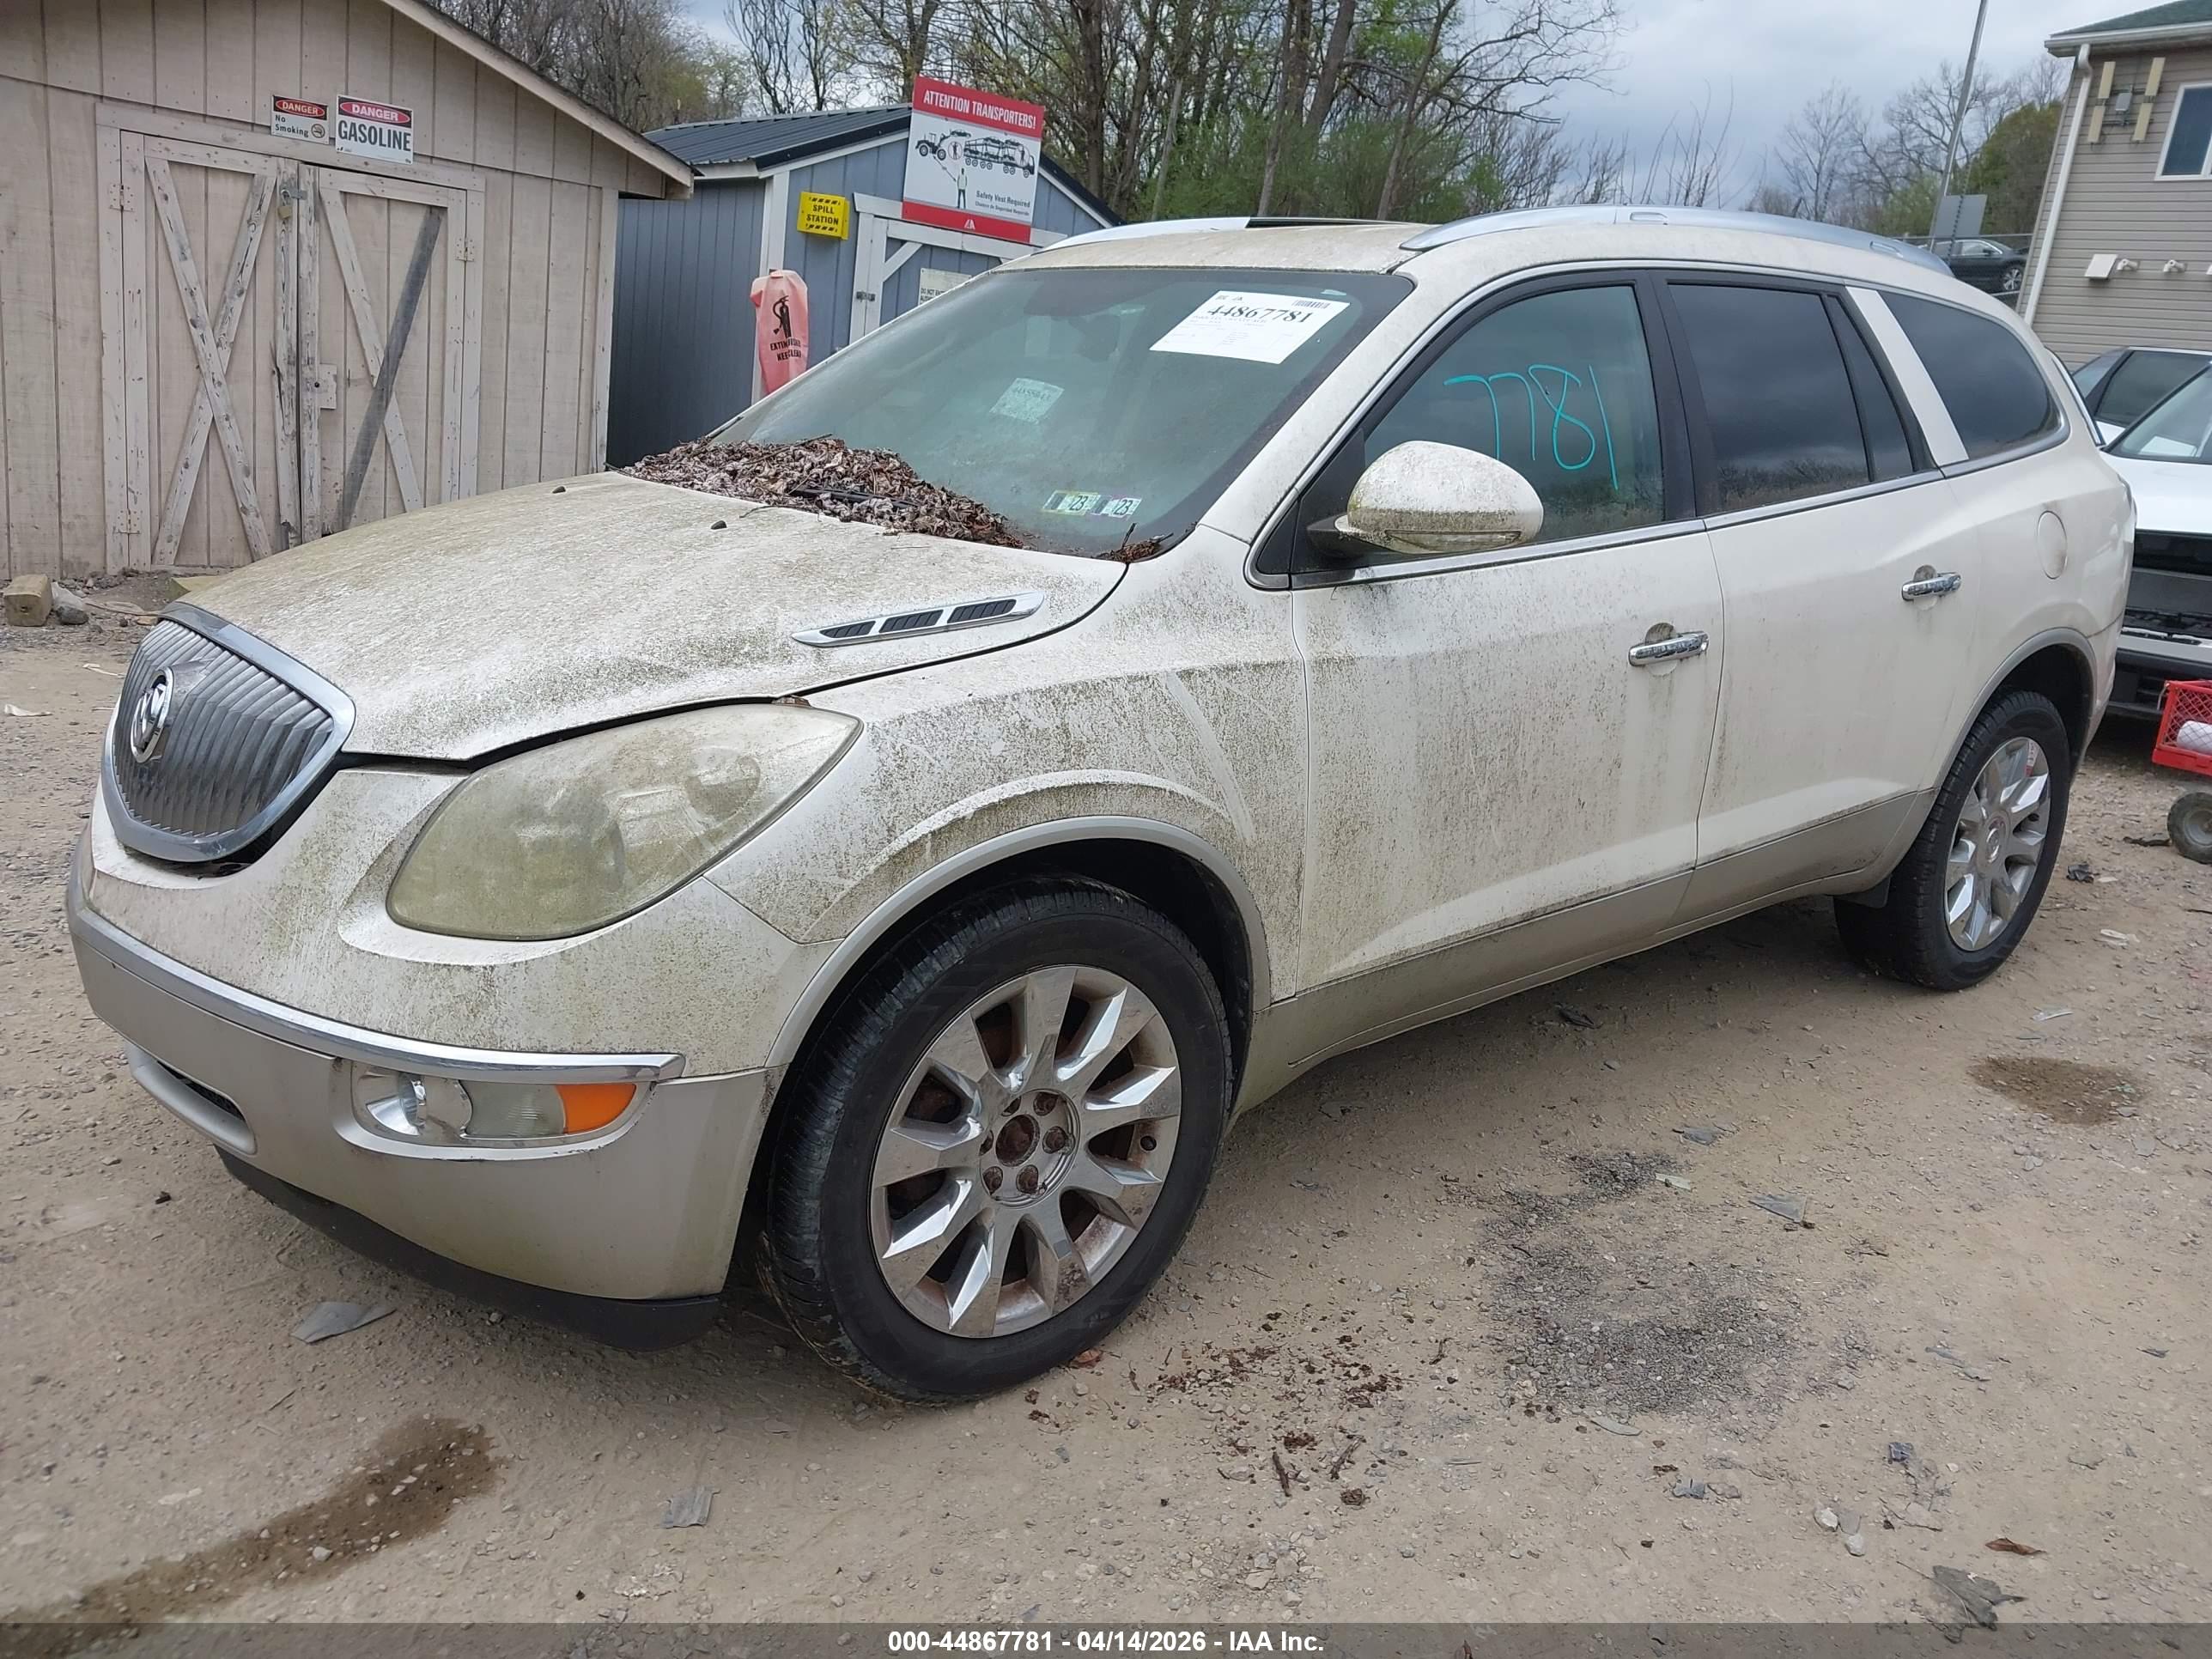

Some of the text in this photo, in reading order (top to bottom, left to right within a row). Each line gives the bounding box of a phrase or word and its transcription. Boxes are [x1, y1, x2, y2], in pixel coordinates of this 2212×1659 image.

[282, 101, 319, 114] DANGER
[351, 103, 398, 122] DANGER
[923, 90, 1036, 130] ATTENTION TRANSPORTERS!
[275, 114, 286, 123] No
[275, 124, 309, 138] Smoking
[337, 119, 411, 152] GASOLINE
[975, 190, 1030, 208] Safety Vest Required
[812, 204, 835, 215] SPILL
[805, 213, 839, 225] STATION
[1206, 305, 1312, 324] 44867781
[1443, 363, 1619, 491] 7781
[1068, 495, 1089, 511] 23
[1112, 499, 1133, 516] 23
